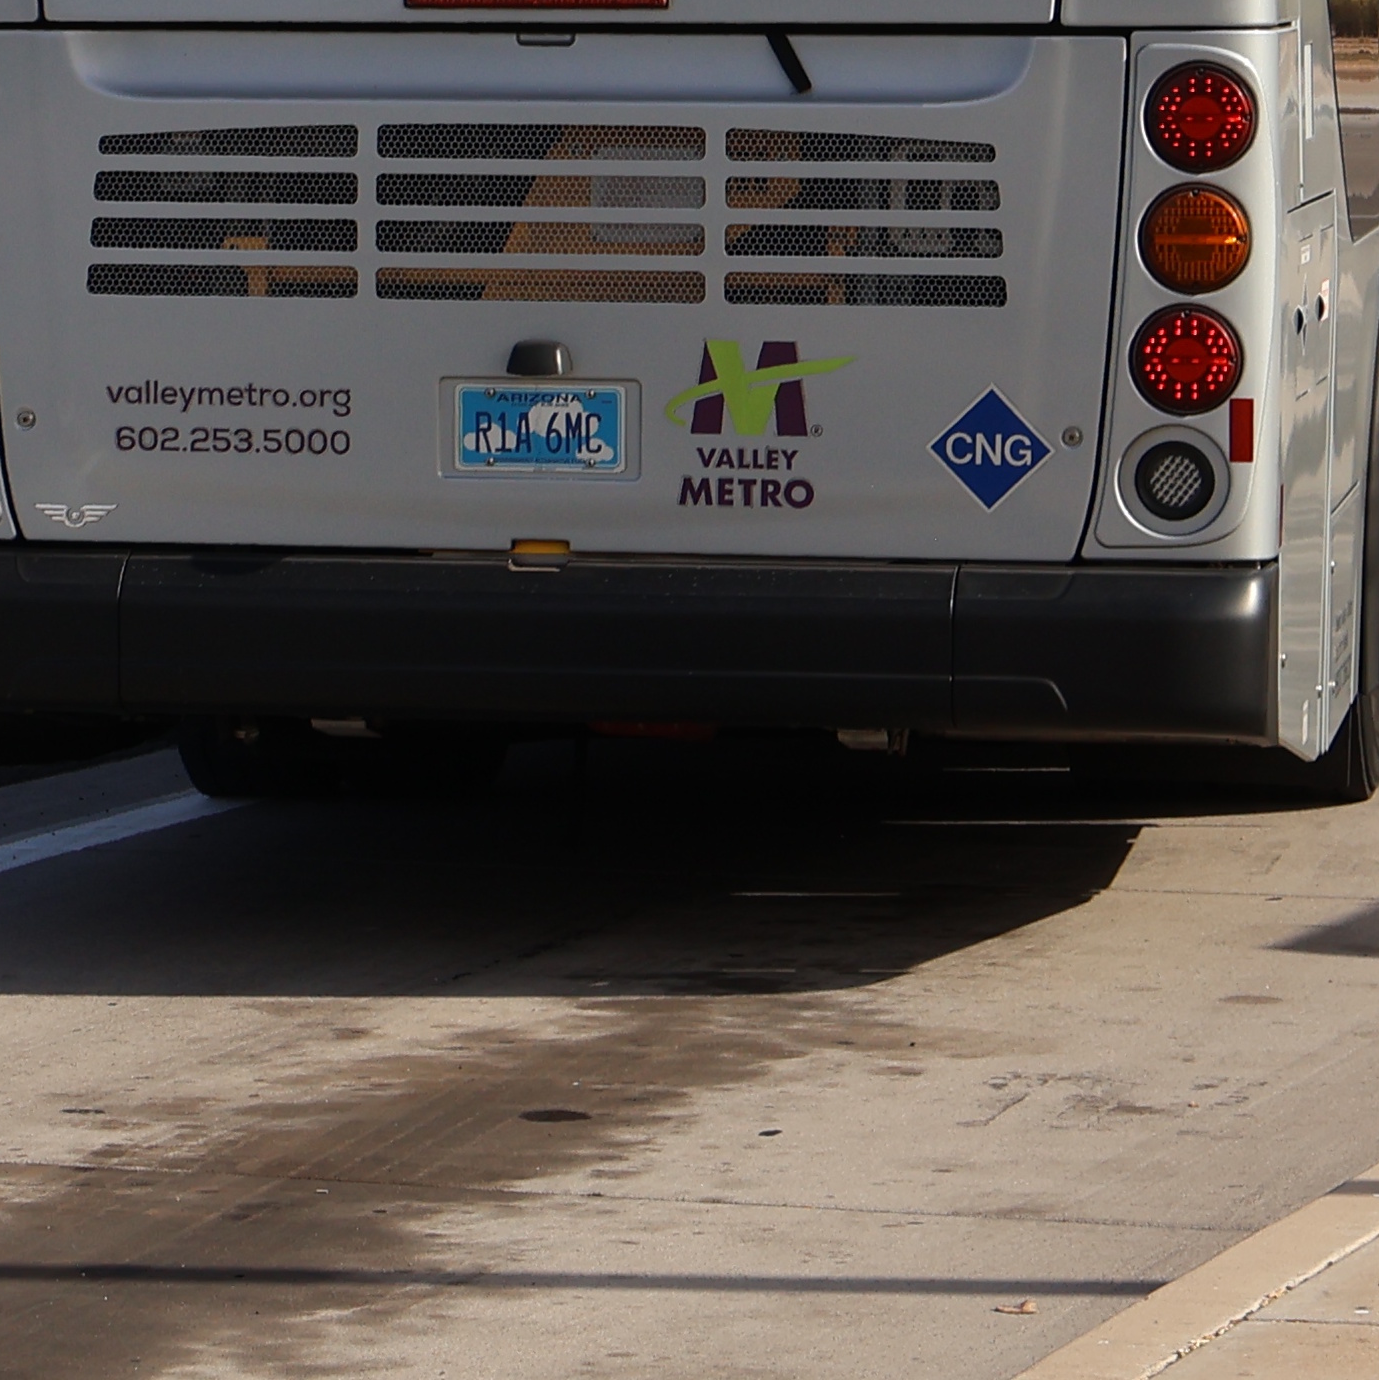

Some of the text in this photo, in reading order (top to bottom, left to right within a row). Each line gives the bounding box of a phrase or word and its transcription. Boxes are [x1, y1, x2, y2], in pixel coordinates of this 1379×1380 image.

[107, 380, 352, 417] valleymetro.org
[496, 393, 583, 403] ARIZONA
[116, 426, 351, 456] 602.253.5000
[474, 411, 603, 454] R1A 6MC
[945, 430, 1034, 467] CNG
[696, 447, 799, 470] VALLEY
[678, 477, 815, 509] METRO
